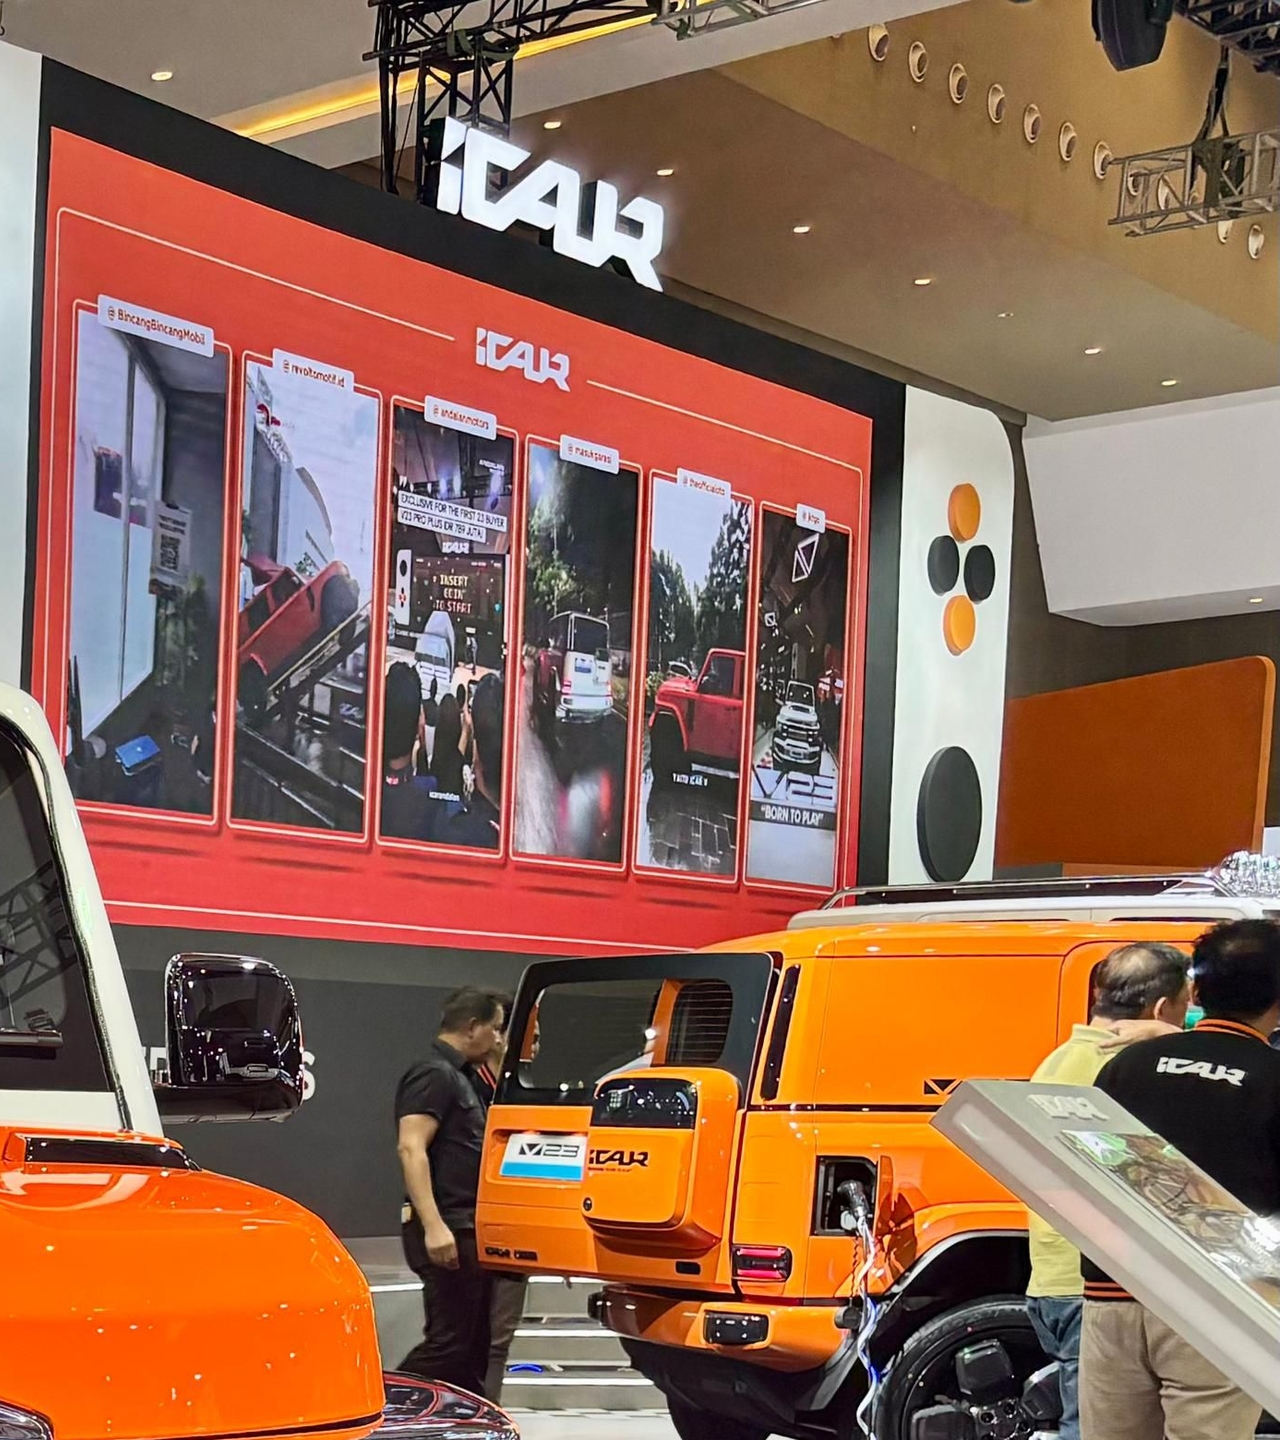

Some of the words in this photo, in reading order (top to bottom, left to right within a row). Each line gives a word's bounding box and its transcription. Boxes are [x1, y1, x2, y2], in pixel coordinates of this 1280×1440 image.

[434, 502, 448, 514] FOR
[448, 504, 459, 517] THE
[790, 807, 801, 823] TO
